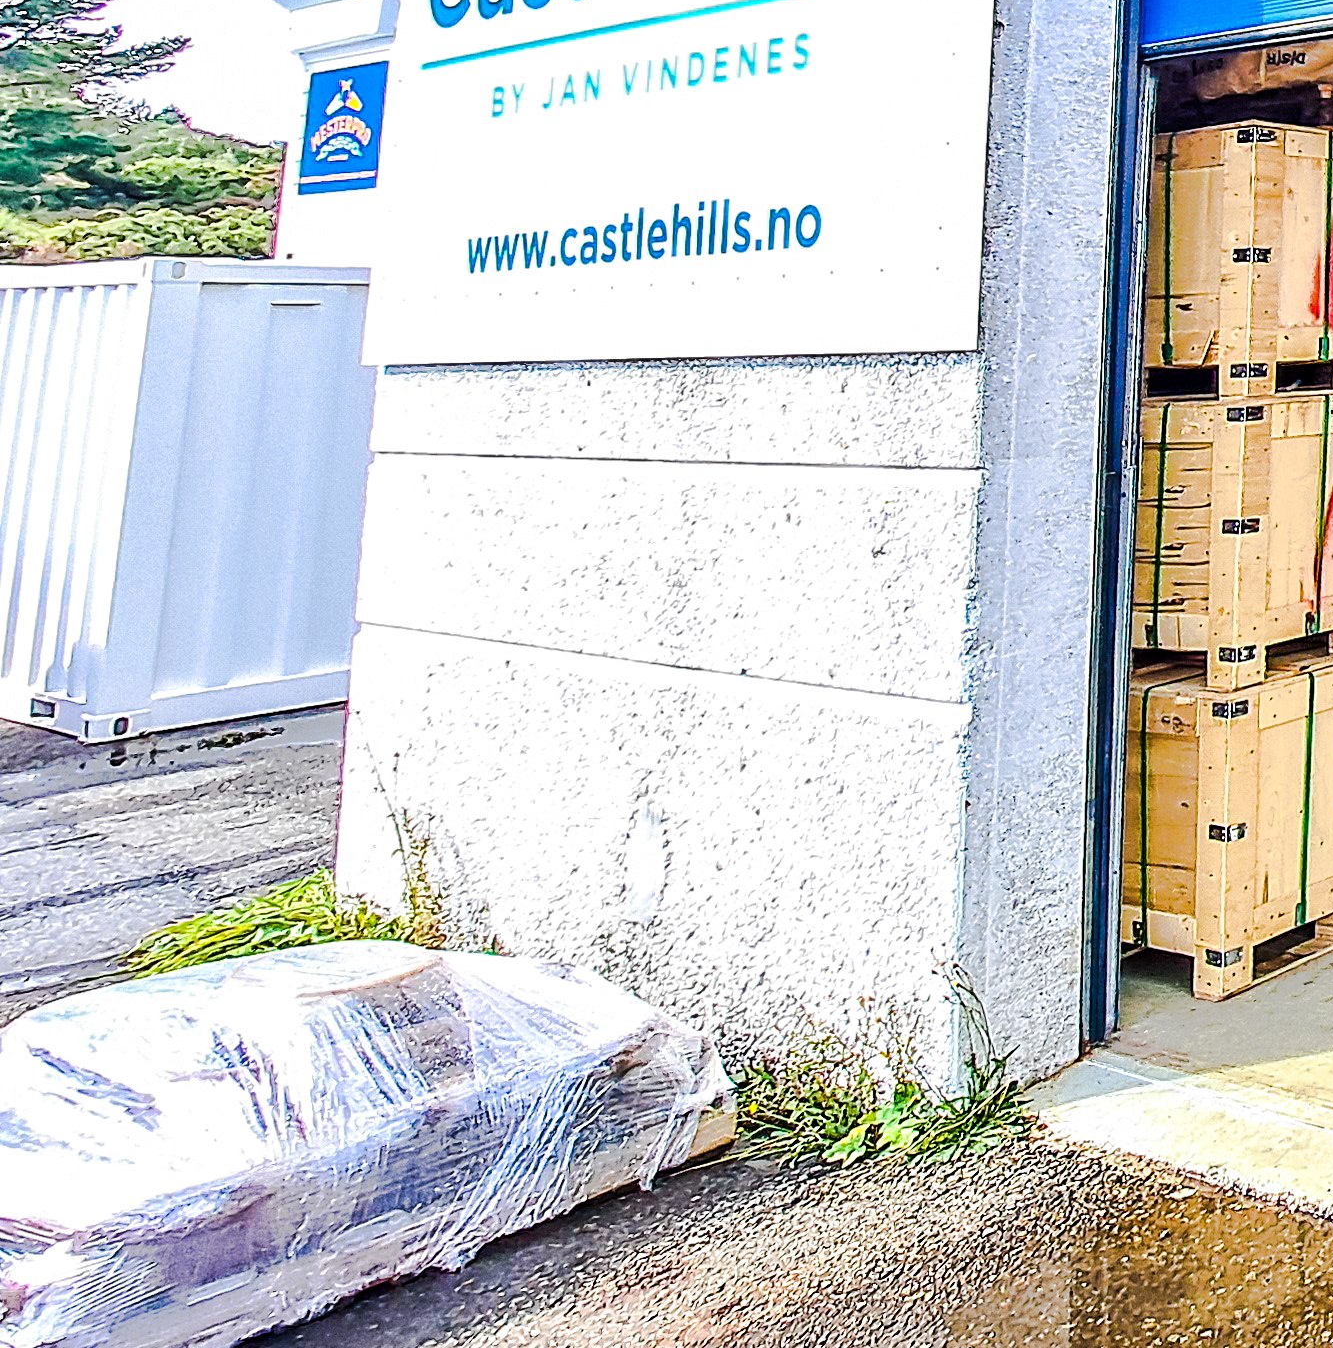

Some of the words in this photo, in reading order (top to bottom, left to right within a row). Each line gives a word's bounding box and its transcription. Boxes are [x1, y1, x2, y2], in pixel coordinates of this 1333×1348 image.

[490, 81, 525, 118] BY
[542, 69, 601, 110] JAN
[622, 33, 811, 94] VINDENES
[467, 198, 822, 275] www.castlehills.no
